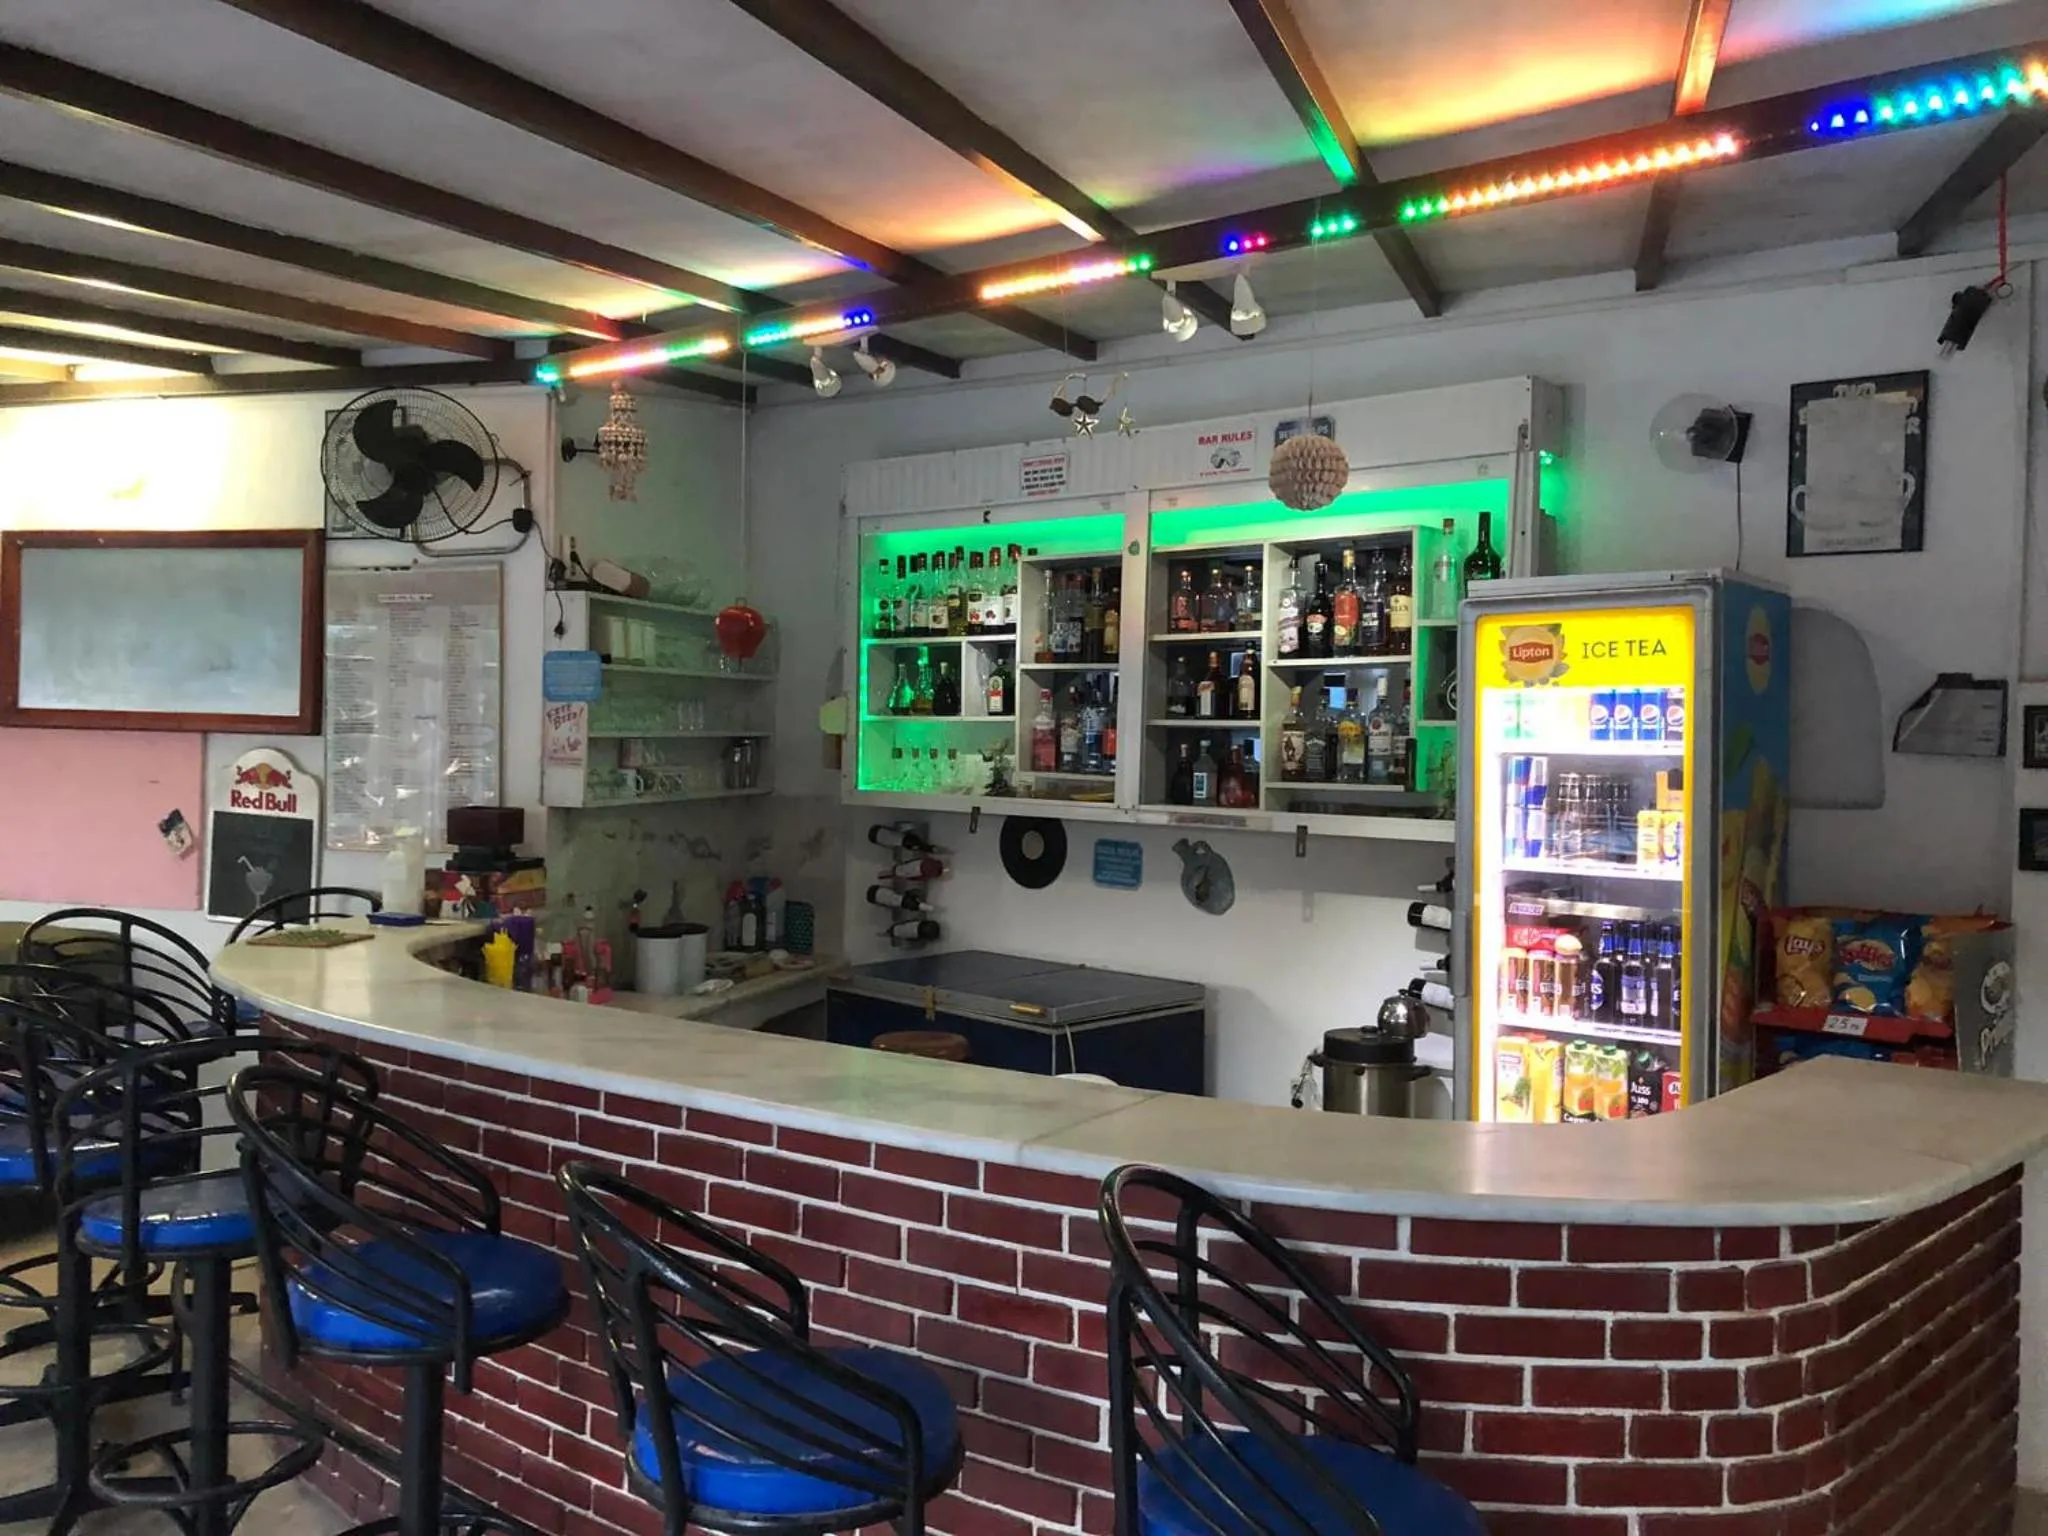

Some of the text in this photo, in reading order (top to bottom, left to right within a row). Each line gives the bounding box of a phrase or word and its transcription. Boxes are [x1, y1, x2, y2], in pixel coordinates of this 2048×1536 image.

[1198, 430, 1253, 446] BAR RULES
[1512, 644, 1551, 663] Lipton
[1582, 638, 1667, 659] ICE TEA
[230, 789, 297, 813] Red Bull
[1828, 1017, 1849, 1029] 25
[1630, 1081, 1652, 1096] Juss
